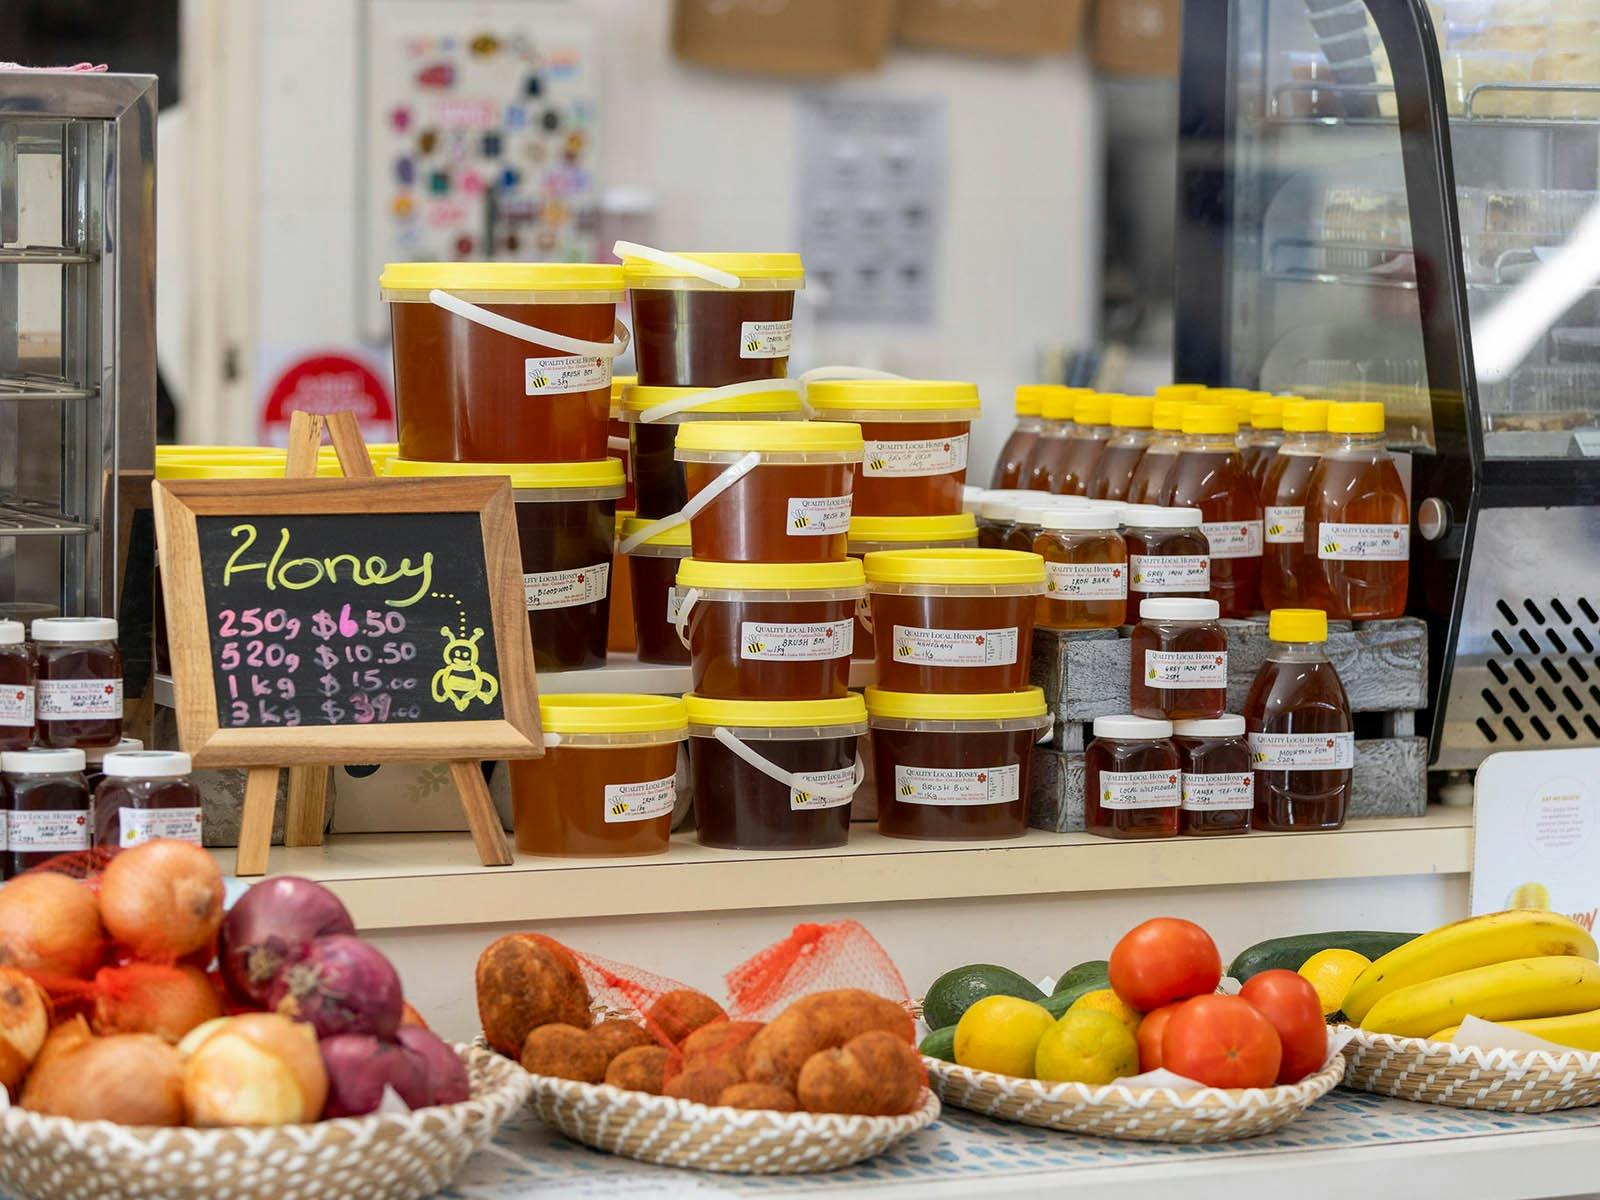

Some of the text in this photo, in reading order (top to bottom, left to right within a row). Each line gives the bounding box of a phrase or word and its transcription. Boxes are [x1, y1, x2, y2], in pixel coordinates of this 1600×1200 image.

[538, 358, 565, 368] QUALITY
[565, 358, 582, 366] LOCAL
[876, 442, 904, 450] QUALITY
[904, 442, 924, 450] LOCAL
[802, 500, 826, 508] QUALITY
[223, 524, 434, 607] Honey
[539, 575, 558, 583] LOCAL
[560, 572, 578, 581] HONEY
[218, 603, 406, 640] 250g $6.50
[755, 625, 826, 634] QUALITY LOCAL HONEY
[904, 630, 976, 640] QUALITY LOCAL HONEY
[782, 638, 808, 648] BRUSH
[1257, 736, 1327, 744] QUALITY LOCAL HONEY
[906, 768, 932, 777] QUALITY
[932, 770, 954, 778] LOCAL
[1130, 774, 1148, 782] LOCAL
[619, 785, 644, 794] QUALITY
[645, 782, 660, 791] LOCAL
